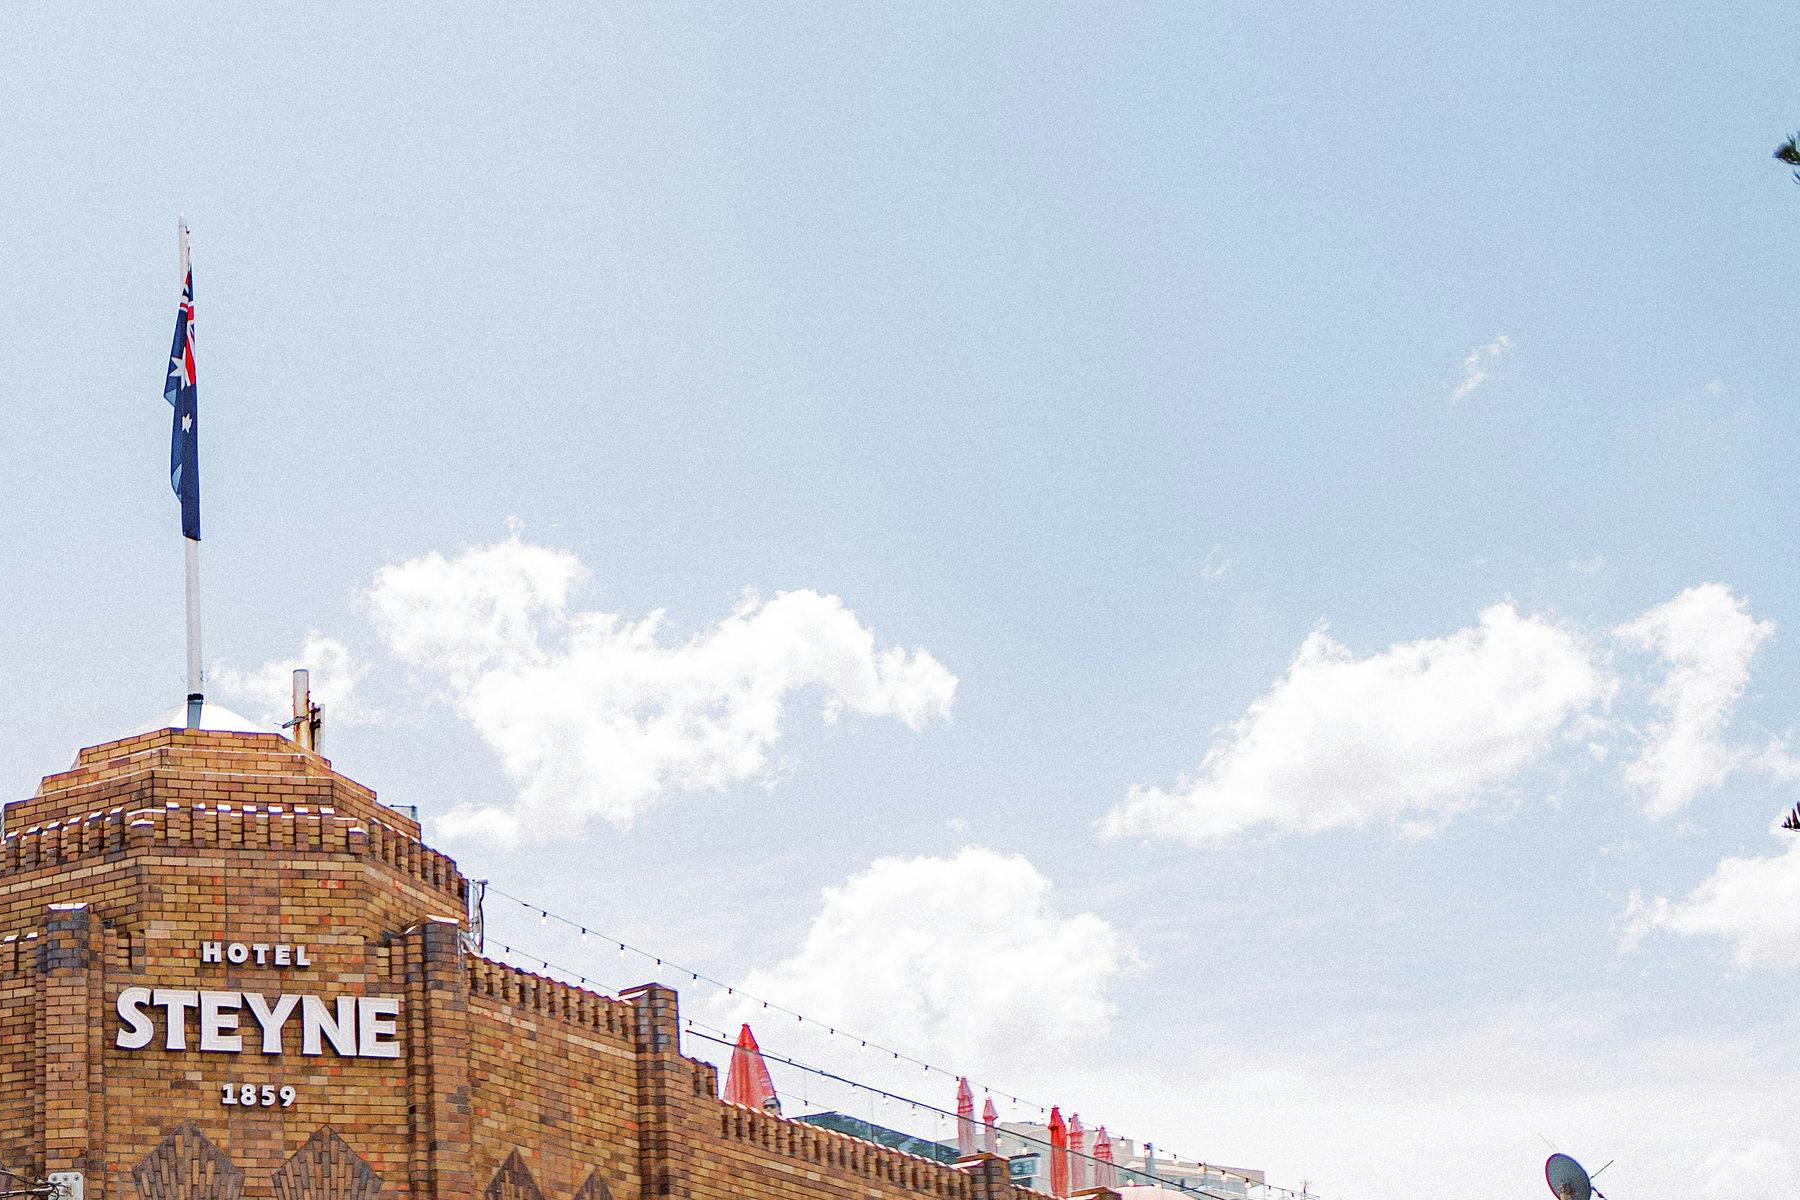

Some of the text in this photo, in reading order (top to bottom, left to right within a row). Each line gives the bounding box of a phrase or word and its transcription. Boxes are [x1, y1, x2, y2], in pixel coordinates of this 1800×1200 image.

[202, 941, 311, 966] HOTEL
[116, 986, 401, 1058] STEYNE
[221, 1083, 297, 1108] 1859
